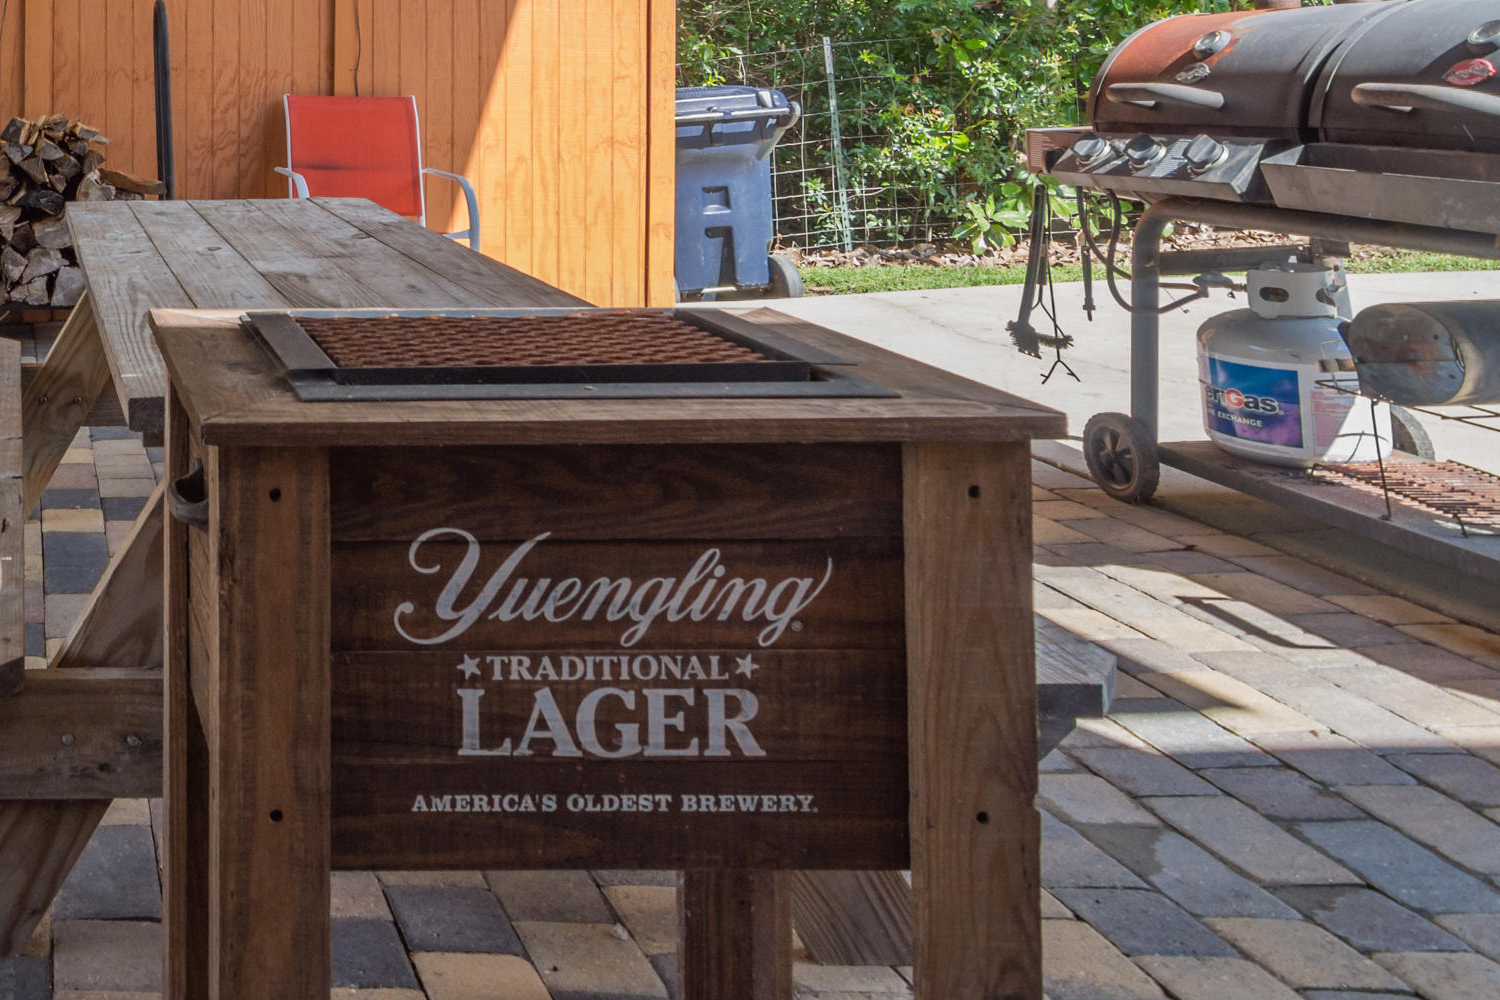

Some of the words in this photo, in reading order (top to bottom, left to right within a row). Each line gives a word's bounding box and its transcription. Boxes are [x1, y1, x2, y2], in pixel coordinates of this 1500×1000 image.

[1217, 411, 1263, 427] EXCHANGE
[393, 527, 833, 648] Yuengling
[486, 655, 729, 682] TRADITIONAL
[456, 687, 767, 759] LAGER
[411, 794, 558, 813] AMERICA'S
[566, 794, 672, 813] OLDEST
